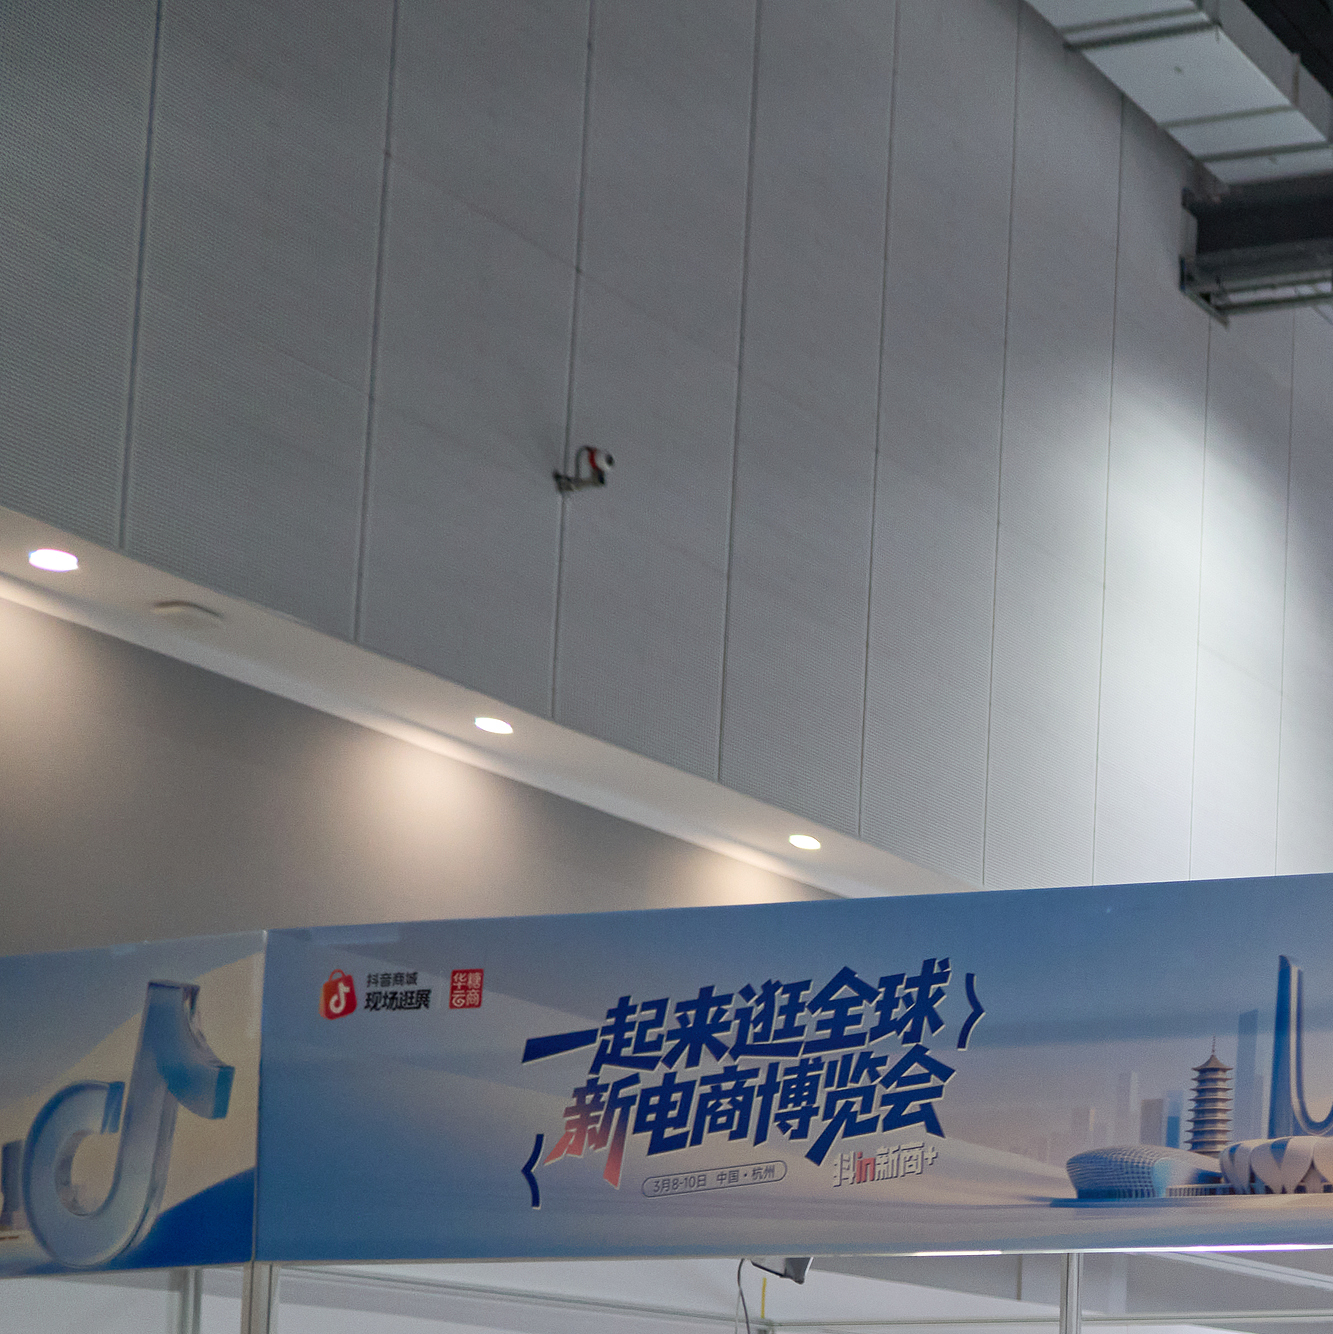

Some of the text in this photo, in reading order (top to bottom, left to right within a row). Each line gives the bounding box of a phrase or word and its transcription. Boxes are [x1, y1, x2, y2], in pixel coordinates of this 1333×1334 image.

[366, 971, 419, 989] 抖音商城
[364, 989, 432, 1012] 现场逛展
[521, 957, 952, 1076] 一起来逛全球
[543, 1042, 957, 1190] 新电商博览会
[651, 1173, 708, 1194] 3月8-10日
